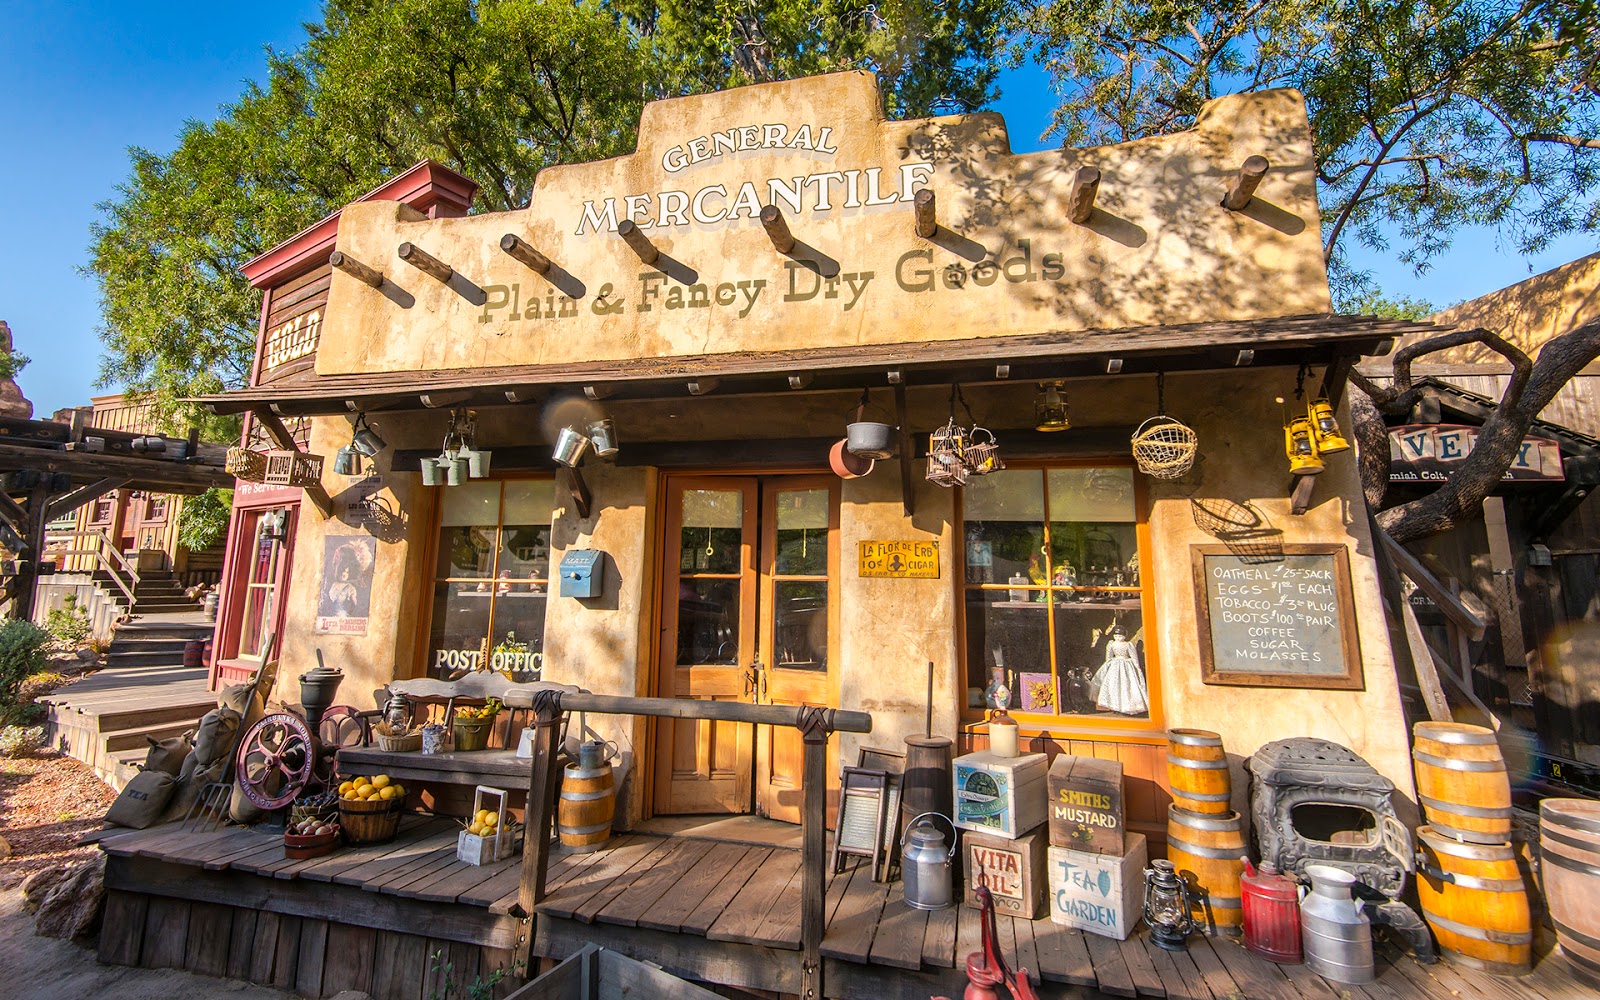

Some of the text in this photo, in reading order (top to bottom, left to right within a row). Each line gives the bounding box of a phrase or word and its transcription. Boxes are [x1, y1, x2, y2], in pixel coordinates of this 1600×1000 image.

[662, 123, 838, 173] GENERAL
[574, 162, 935, 236] MERCANTILE
[478, 238, 1065, 324] Plain & Fancy Dry Goods
[1403, 432, 1532, 468] VEY
[863, 542, 933, 558] LA FLOR DE ERB
[565, 557, 592, 565] MAIL
[908, 560, 935, 570] CIGAR
[1302, 568, 1333, 580] SACK
[1298, 583, 1333, 596] EACH
[1306, 599, 1337, 613] PLUG
[1305, 615, 1336, 629] PAIR
[1248, 627, 1296, 638] COFFEE
[1249, 639, 1305, 651] SUGAR
[434, 649, 542, 673] POST OFFIC
[1235, 648, 1322, 662] MOLASSES
[1553, 764, 1560, 776] 2
[128, 789, 149, 801] TEA
[1060, 788, 1111, 810] SMITHS
[1055, 806, 1117, 829] MUSTARD
[973, 848, 1018, 874] VITA
[977, 872, 1013, 895] OIL
[1058, 860, 1097, 892] TEA
[1056, 889, 1117, 927] GARDEN
